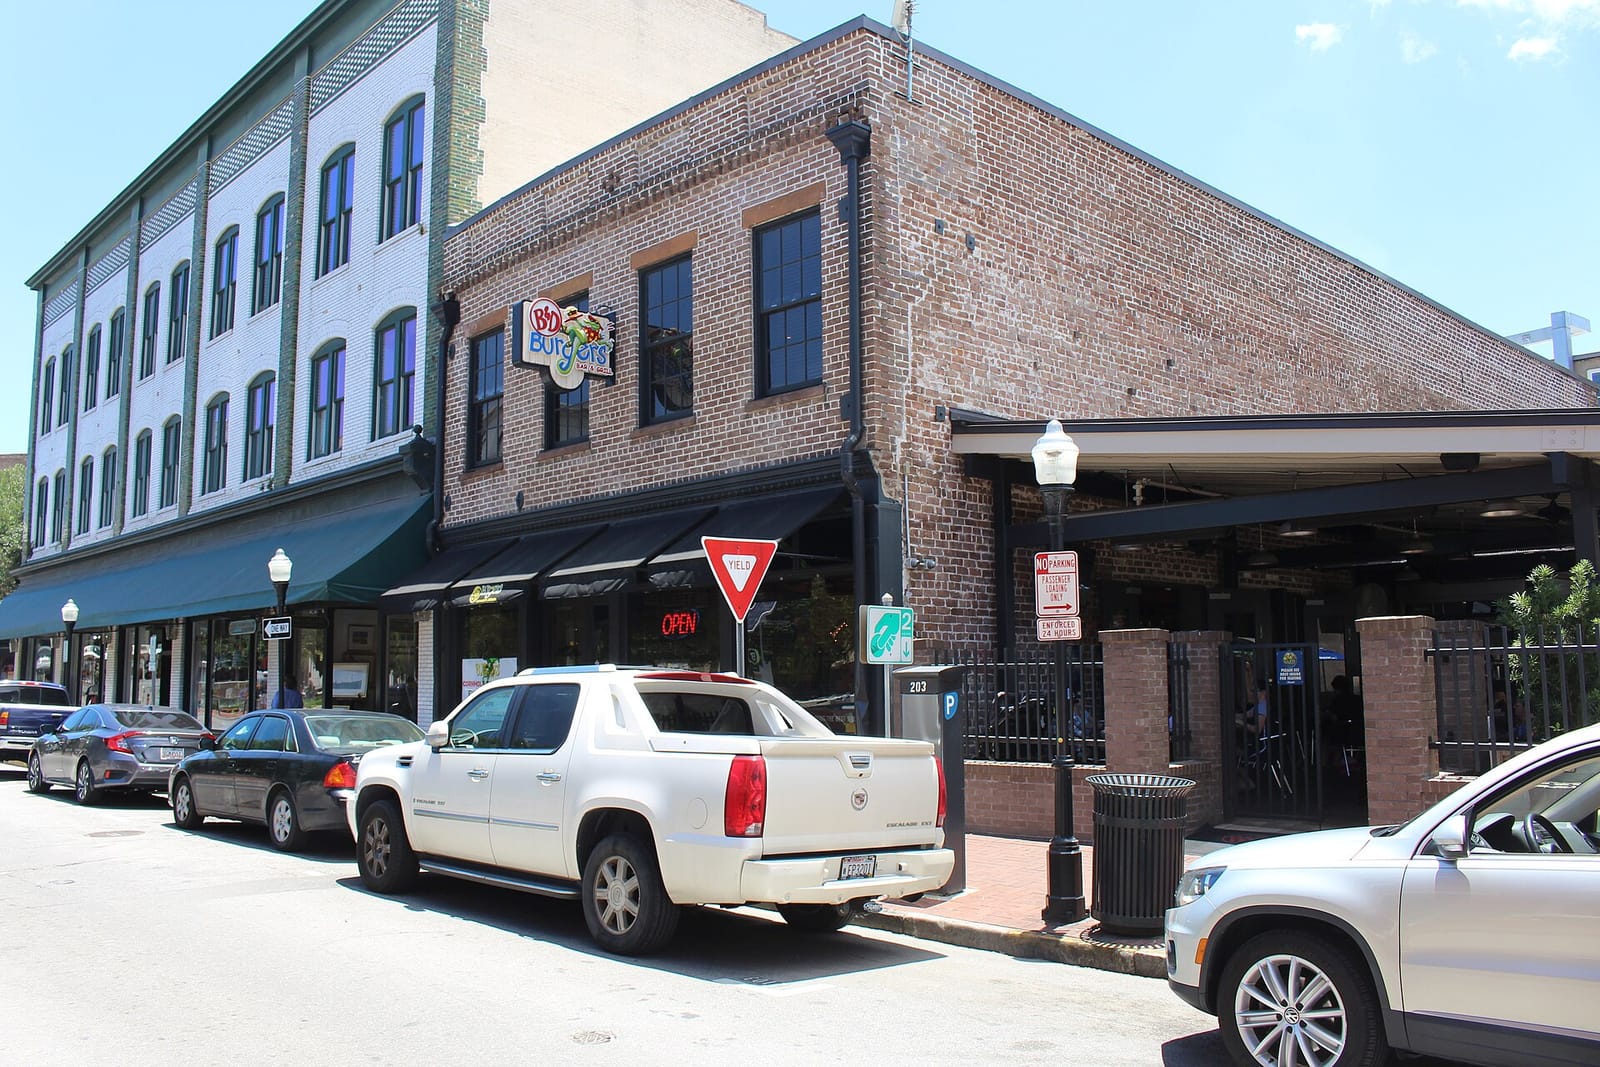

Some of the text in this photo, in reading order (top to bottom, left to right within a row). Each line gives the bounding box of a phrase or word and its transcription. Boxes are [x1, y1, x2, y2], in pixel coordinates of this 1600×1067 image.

[533, 305, 560, 332] B&D
[529, 331, 607, 371] Burgers
[576, 362, 587, 370] BAR
[728, 560, 751, 570] YIELD
[1036, 558, 1075, 570] NO PARKING
[1041, 575, 1071, 584] PASSENGER
[1045, 584, 1068, 593] LOADING
[1050, 593, 1064, 602] ONLY
[661, 612, 697, 635] OPEN
[901, 612, 912, 630] 2
[1042, 621, 1076, 630] ENFORCED
[271, 623, 288, 632] ONE WAY
[1054, 629, 1077, 637] HOURS
[910, 681, 927, 693] 203
[946, 695, 955, 715] P
